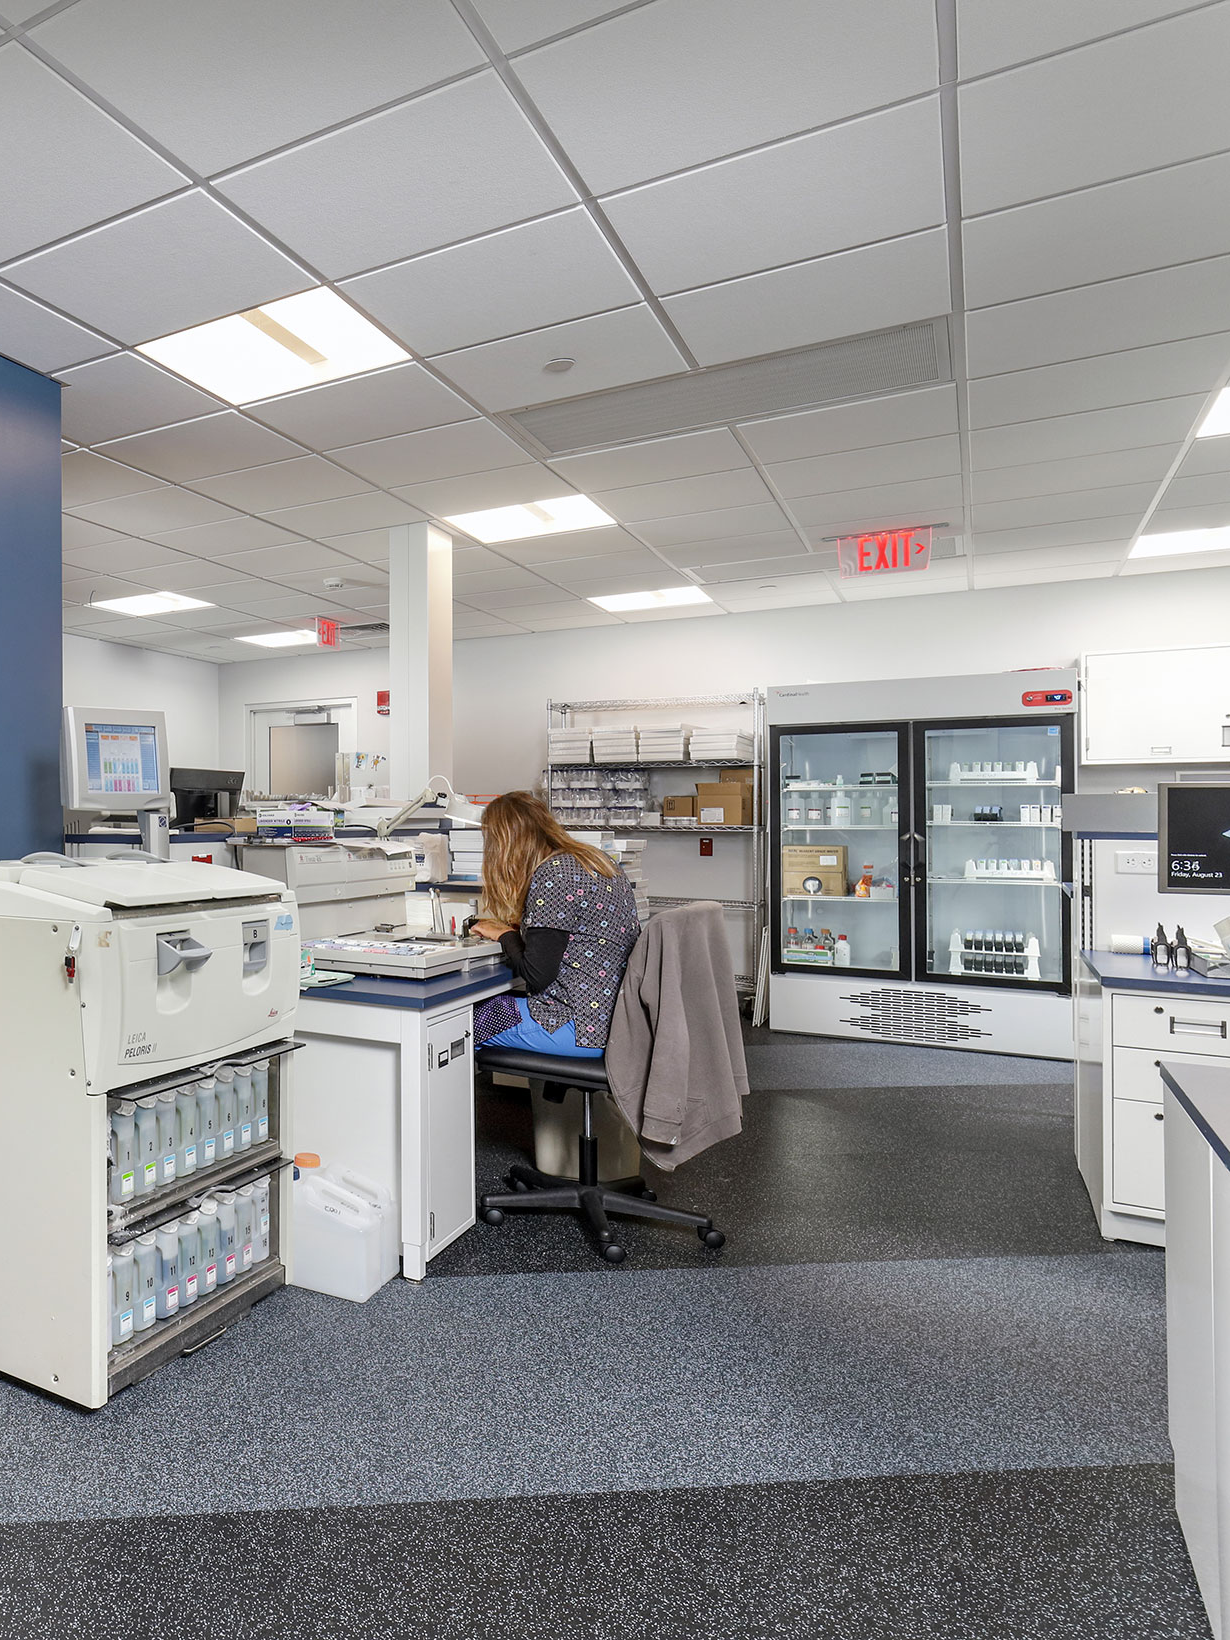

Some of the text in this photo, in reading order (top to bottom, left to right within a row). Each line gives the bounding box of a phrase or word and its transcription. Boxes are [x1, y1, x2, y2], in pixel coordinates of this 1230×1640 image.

[858, 531, 915, 572] EXIT
[322, 620, 336, 647] EXIT
[128, 1032, 146, 1044] LEICA
[124, 1044, 152, 1058] PELORIS
